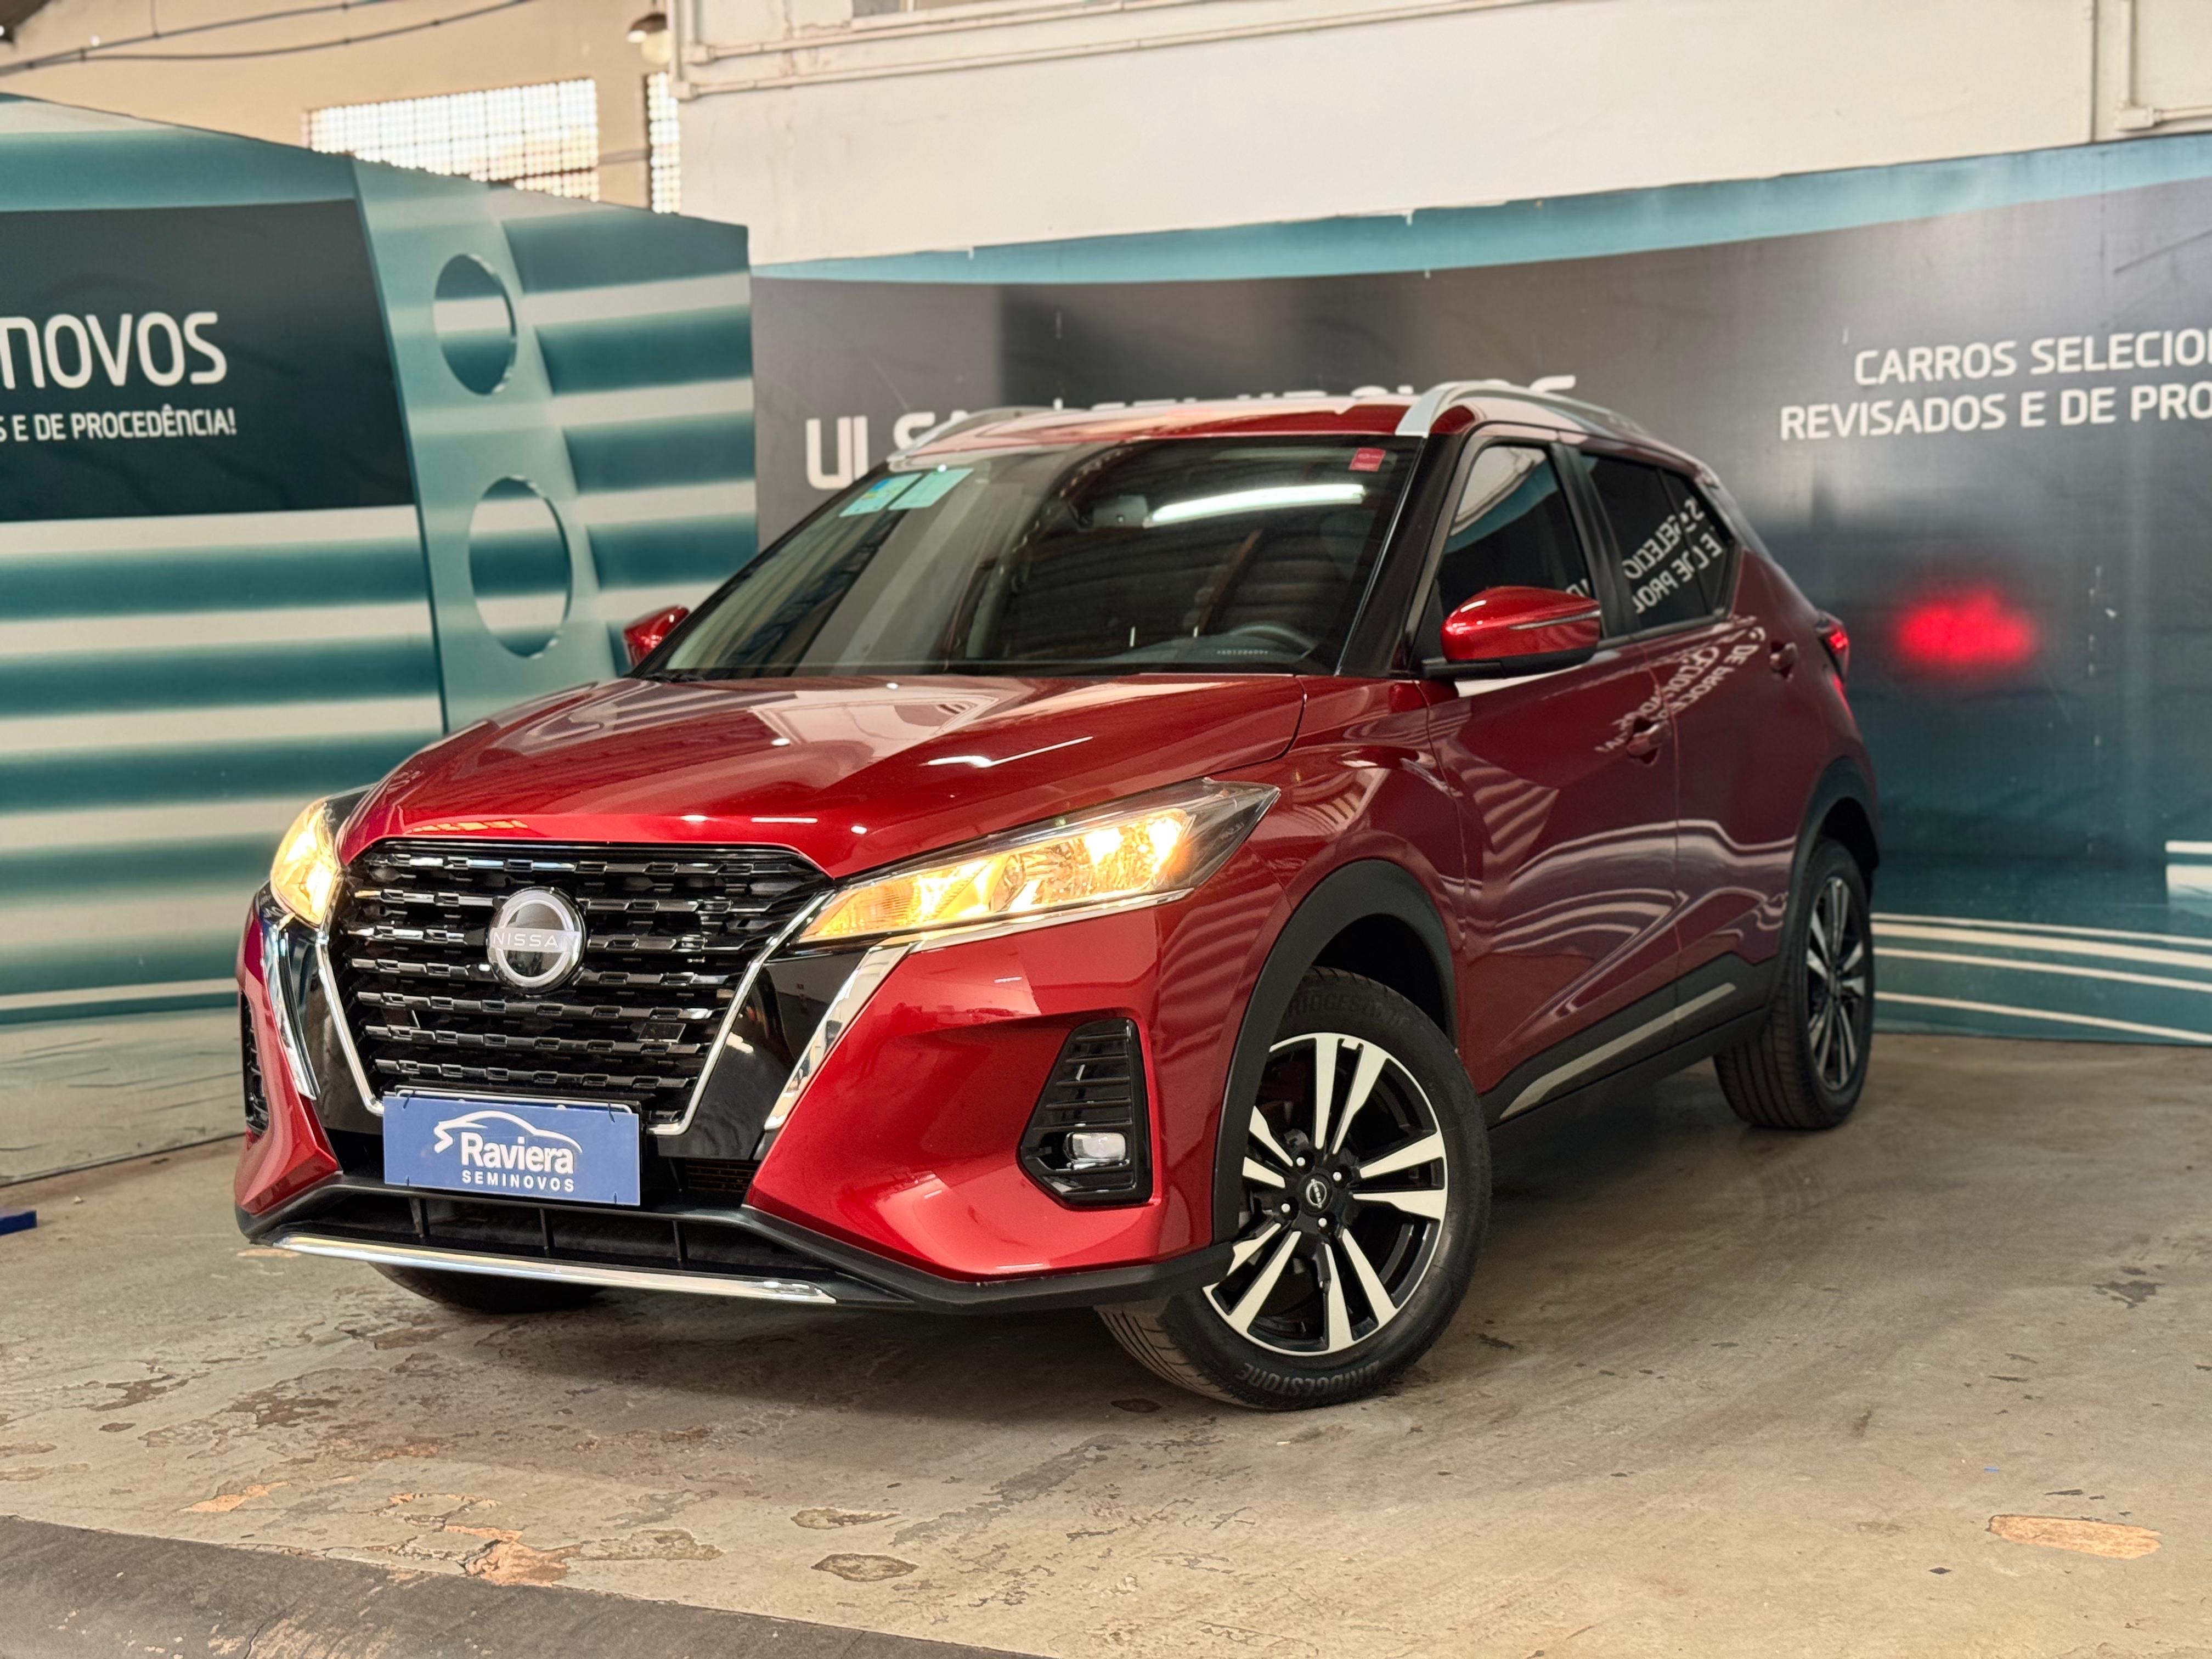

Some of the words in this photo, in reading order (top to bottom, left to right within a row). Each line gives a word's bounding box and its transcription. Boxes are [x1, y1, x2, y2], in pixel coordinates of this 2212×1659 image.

[1854, 340, 2017, 385] CARROS
[2030, 329, 2212, 375] SELECIO
[12, 414, 29, 441] E
[33, 414, 66, 441] DE
[70, 403, 237, 439] PROCEDÊNCIA!
[1781, 393, 2007, 441] REVISADOS
[2021, 391, 2046, 428] E
[2060, 387, 2116, 425] DE
[493, 932, 578, 949] NISSAN
[461, 1132, 574, 1174] Raviera
[462, 1169, 574, 1193] SEMINOVOS
